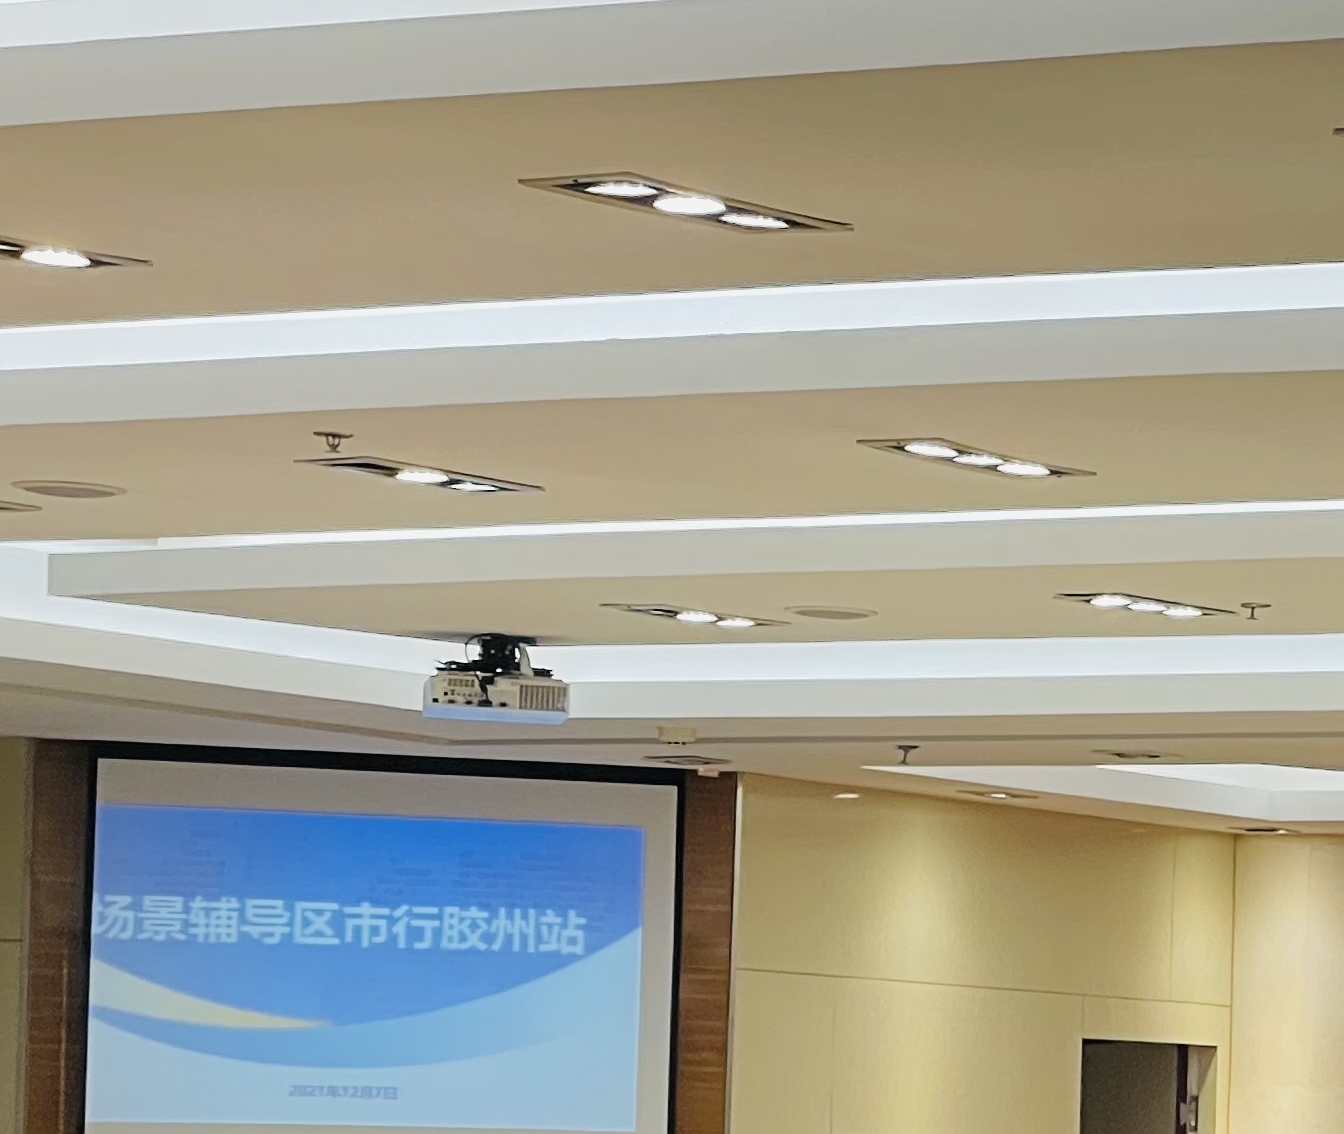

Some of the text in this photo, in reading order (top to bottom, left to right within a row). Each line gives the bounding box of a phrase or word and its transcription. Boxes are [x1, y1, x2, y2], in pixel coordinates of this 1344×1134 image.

[92, 895, 586, 955] 场景辅导区市行胶州站
